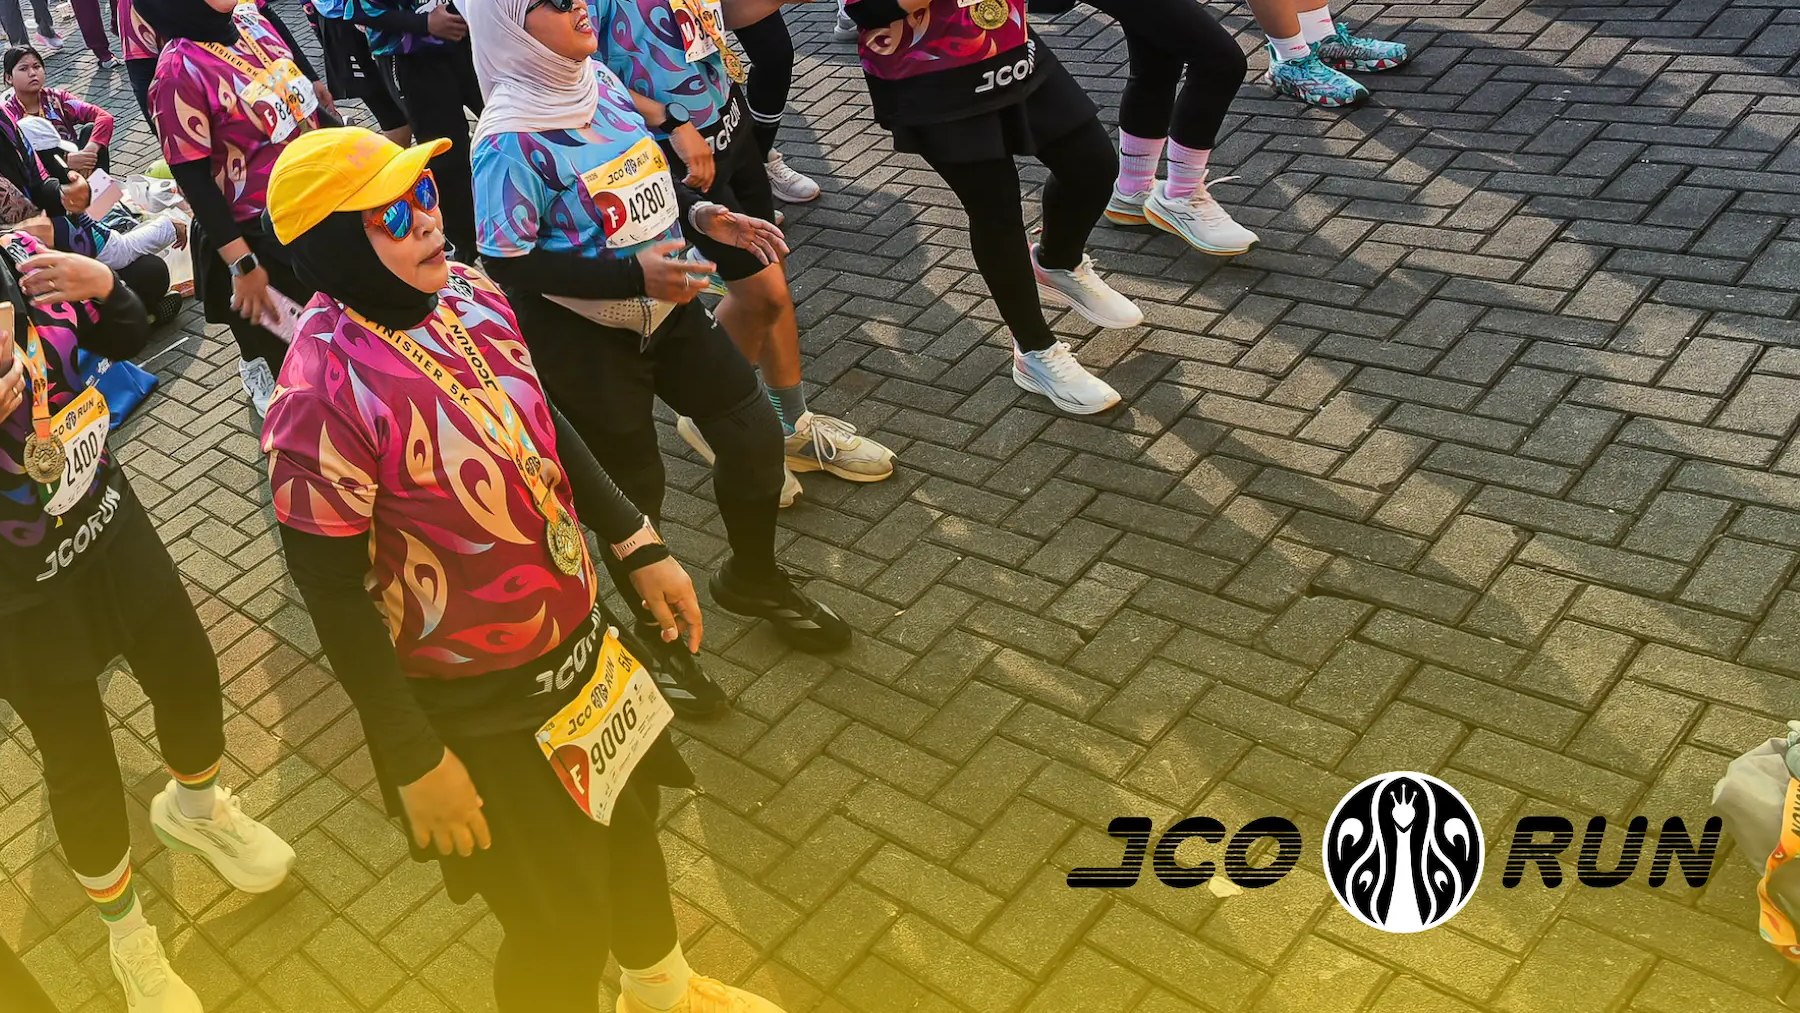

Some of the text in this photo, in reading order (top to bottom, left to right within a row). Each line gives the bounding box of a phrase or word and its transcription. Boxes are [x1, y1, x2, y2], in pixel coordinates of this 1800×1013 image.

[680, 21, 692, 42] M
[263, 109, 275, 127] F
[607, 170, 624, 185] JCO
[606, 181, 665, 228] F 4280
[450, 323, 499, 392] JCORUN
[77, 397, 94, 419] RUN
[450, 384, 471, 406] 5K
[36, 485, 120, 582] JCORUN
[567, 650, 634, 736] JCO RUN 5K
[569, 700, 637, 795] F 9006
